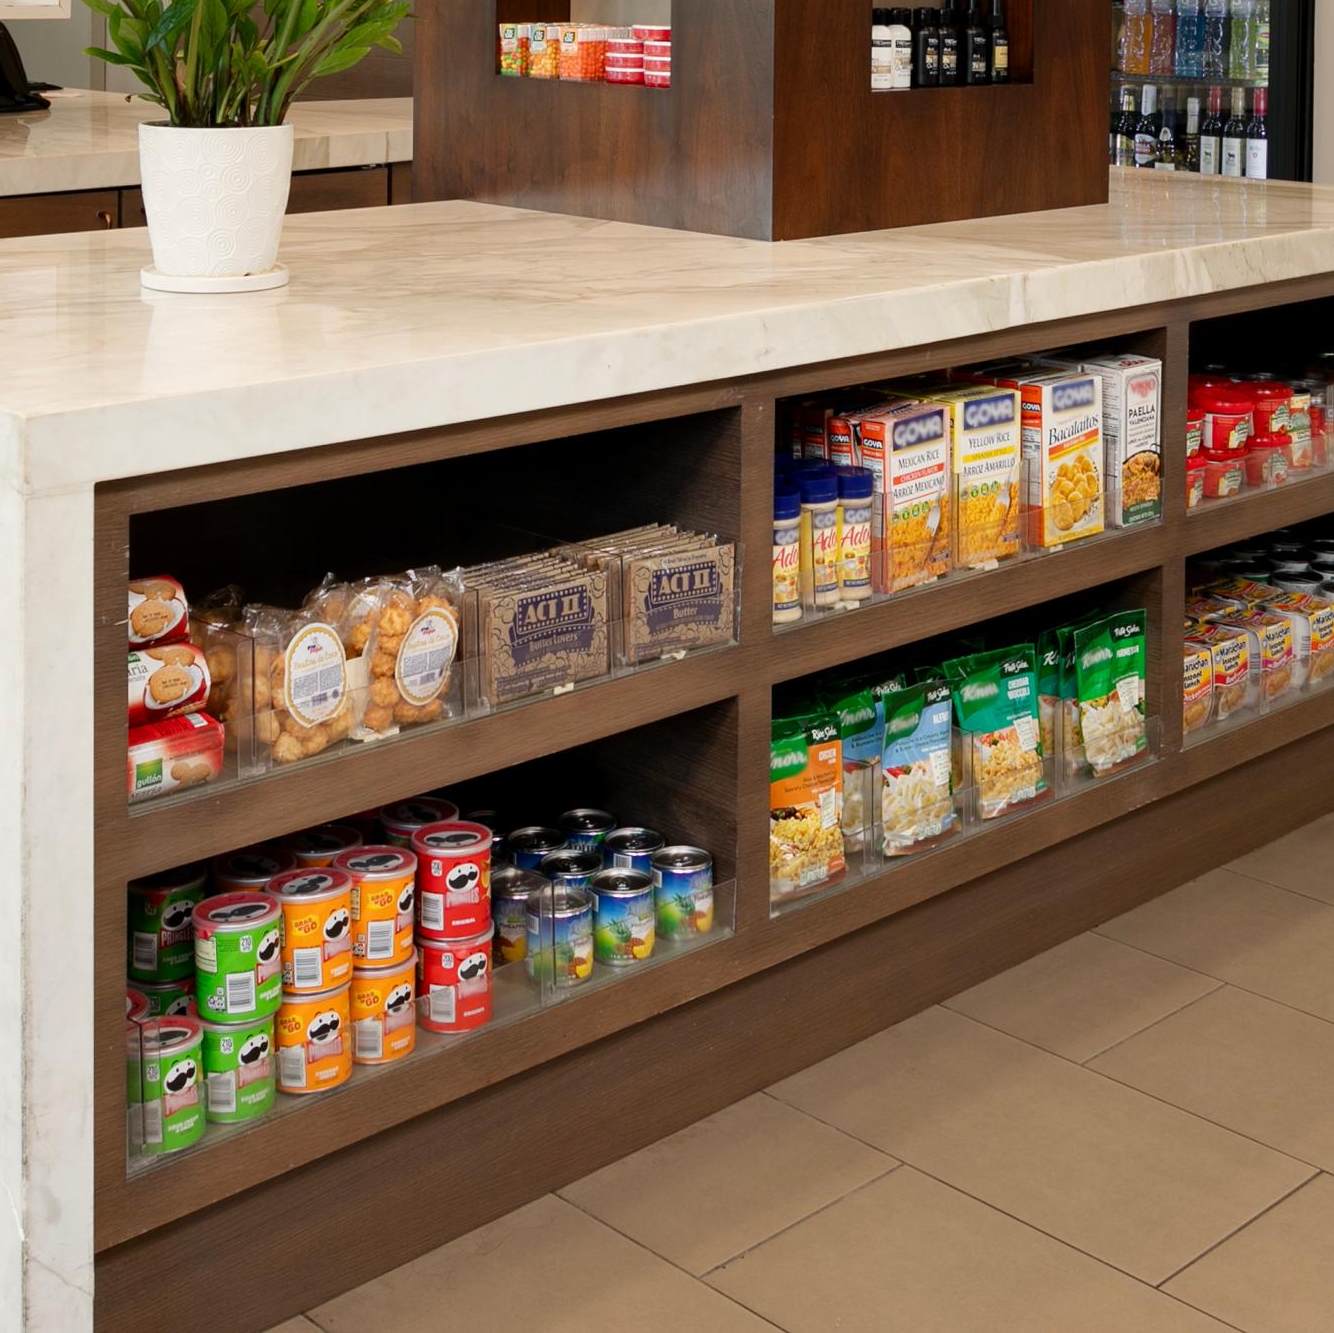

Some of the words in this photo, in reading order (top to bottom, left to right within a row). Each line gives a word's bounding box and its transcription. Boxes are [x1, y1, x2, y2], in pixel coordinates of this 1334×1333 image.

[1055, 385, 1093, 409] GOYA
[1022, 403, 1041, 411] GOYA
[1128, 404, 1155, 418] PAELLA
[966, 400, 1013, 427] GOYA
[894, 415, 942, 446] GOYA
[1049, 415, 1099, 445] Bacalaitos
[830, 434, 849, 443] GOYA
[863, 438, 883, 449] GOYA
[968, 435, 995, 449] YELLOW
[996, 431, 1010, 443] RICE
[898, 452, 926, 470] MEXICAN
[926, 449, 939, 462] RICE
[964, 464, 984, 477] ARROZ
[984, 458, 1015, 471] AMARILLO
[894, 484, 913, 499] ARROZ
[914, 476, 944, 492] MEXICANO
[659, 572, 689, 596] ACT
[693, 568, 712, 589] II
[524, 601, 557, 623] ACT
[561, 595, 581, 615] II
[673, 607, 698, 619] Butter
[1318, 622, 1334, 632] Instant
[1266, 627, 1291, 640] Maruchan
[1320, 629, 1333, 639] Lunch
[529, 640, 552, 652] Butter
[1219, 641, 1246, 656] Maruchan
[1268, 639, 1285, 650] Instant
[1271, 646, 1284, 657] Lunch
[1184, 659, 1209, 672] aruchan
[1222, 654, 1240, 665] Instant
[1224, 661, 1239, 671] Lunch
[1183, 672, 1203, 681] nstant
[771, 750, 807, 769] norr
[136, 773, 163, 789] gullón
[379, 895, 393, 907] GO
[303, 921, 317, 933] GO
[366, 996, 379, 1007] GO
[287, 1022, 301, 1033] GO
